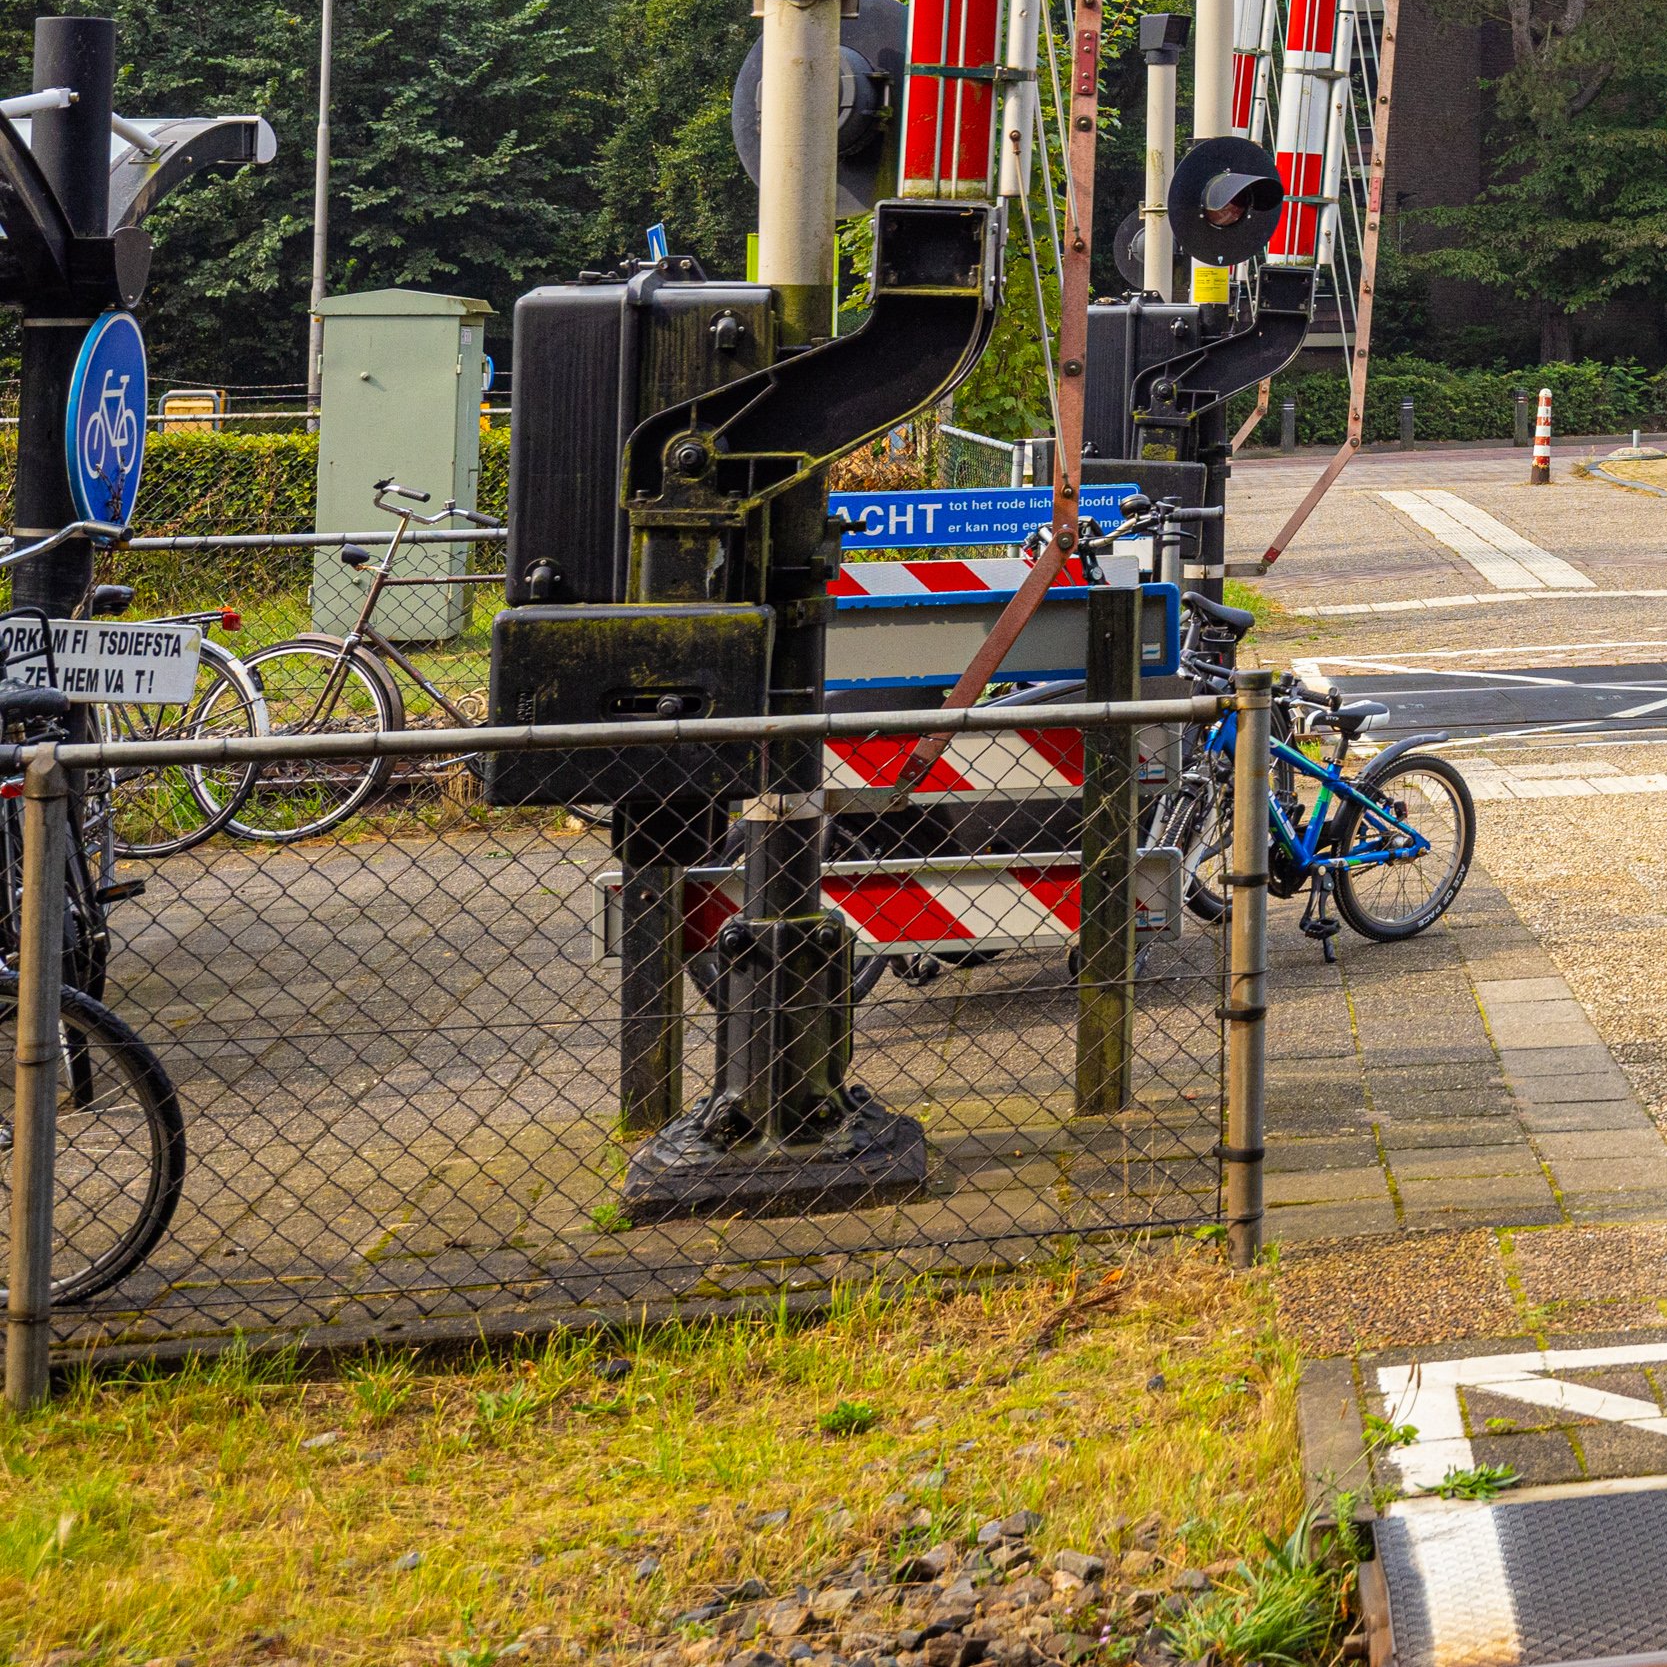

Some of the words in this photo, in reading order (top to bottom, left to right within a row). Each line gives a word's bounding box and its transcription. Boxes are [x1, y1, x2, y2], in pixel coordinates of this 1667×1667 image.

[835, 503, 943, 536] ACHT
[949, 500, 968, 511] tot
[972, 499, 993, 510] het
[997, 497, 1026, 510] rode
[1029, 497, 1054, 509] lich
[1078, 496, 1113, 507] doofd
[948, 523, 963, 533] er
[965, 521, 989, 533] kan
[993, 521, 1018, 535] nog
[63, 667, 100, 693] HEM
[1417, 905, 1442, 928] PACE
